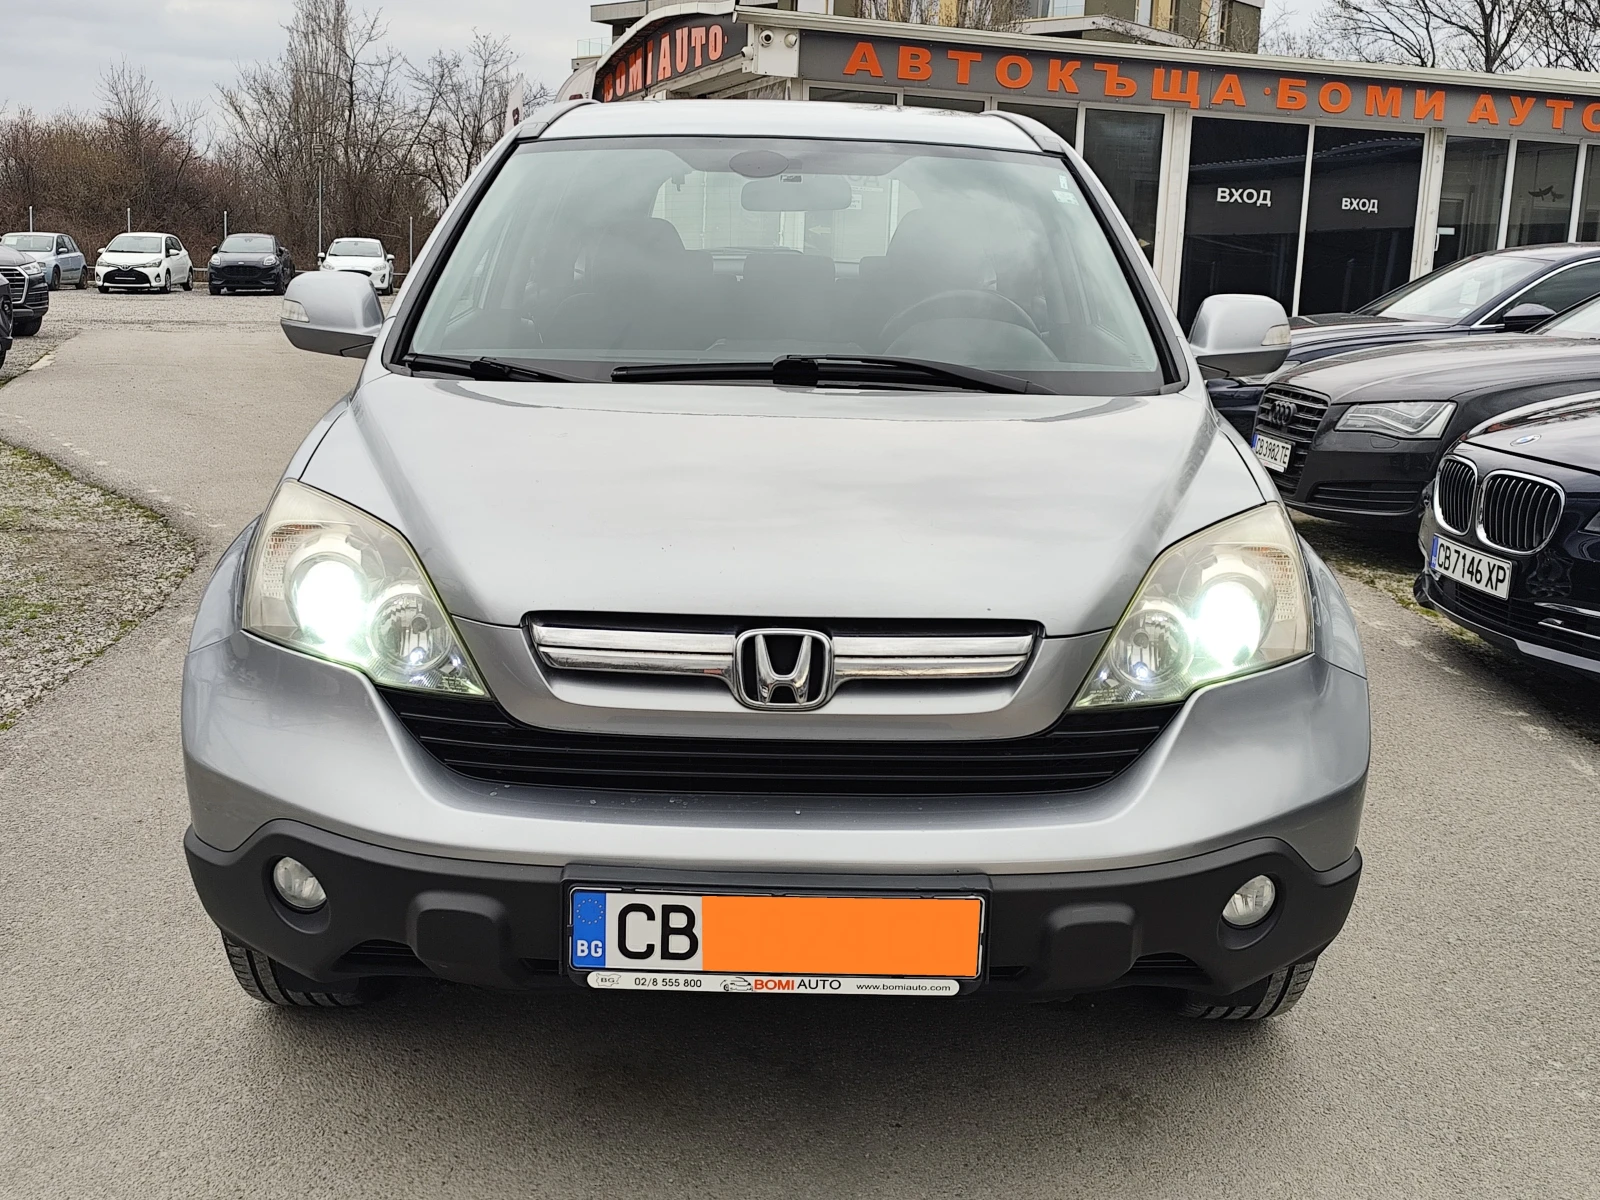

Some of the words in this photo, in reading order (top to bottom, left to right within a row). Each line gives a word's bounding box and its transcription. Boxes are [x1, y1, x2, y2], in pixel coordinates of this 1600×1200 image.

[603, 39, 655, 103] BOMI
[842, 41, 1247, 109] АВТОКЪЩА
[1216, 187, 1272, 208] ВХОД
[1341, 197, 1379, 214] ВХОД
[1484, 561, 1507, 592] XP
[617, 902, 699, 961] CB
[576, 939, 603, 958] BG
[634, 976, 659, 988] 02/8
[661, 978, 680, 988] 555
[683, 978, 702, 989] 800
[754, 979, 795, 991] BOMI
[796, 979, 842, 990] AUTO
[855, 983, 952, 992] www.bomiauto.com
